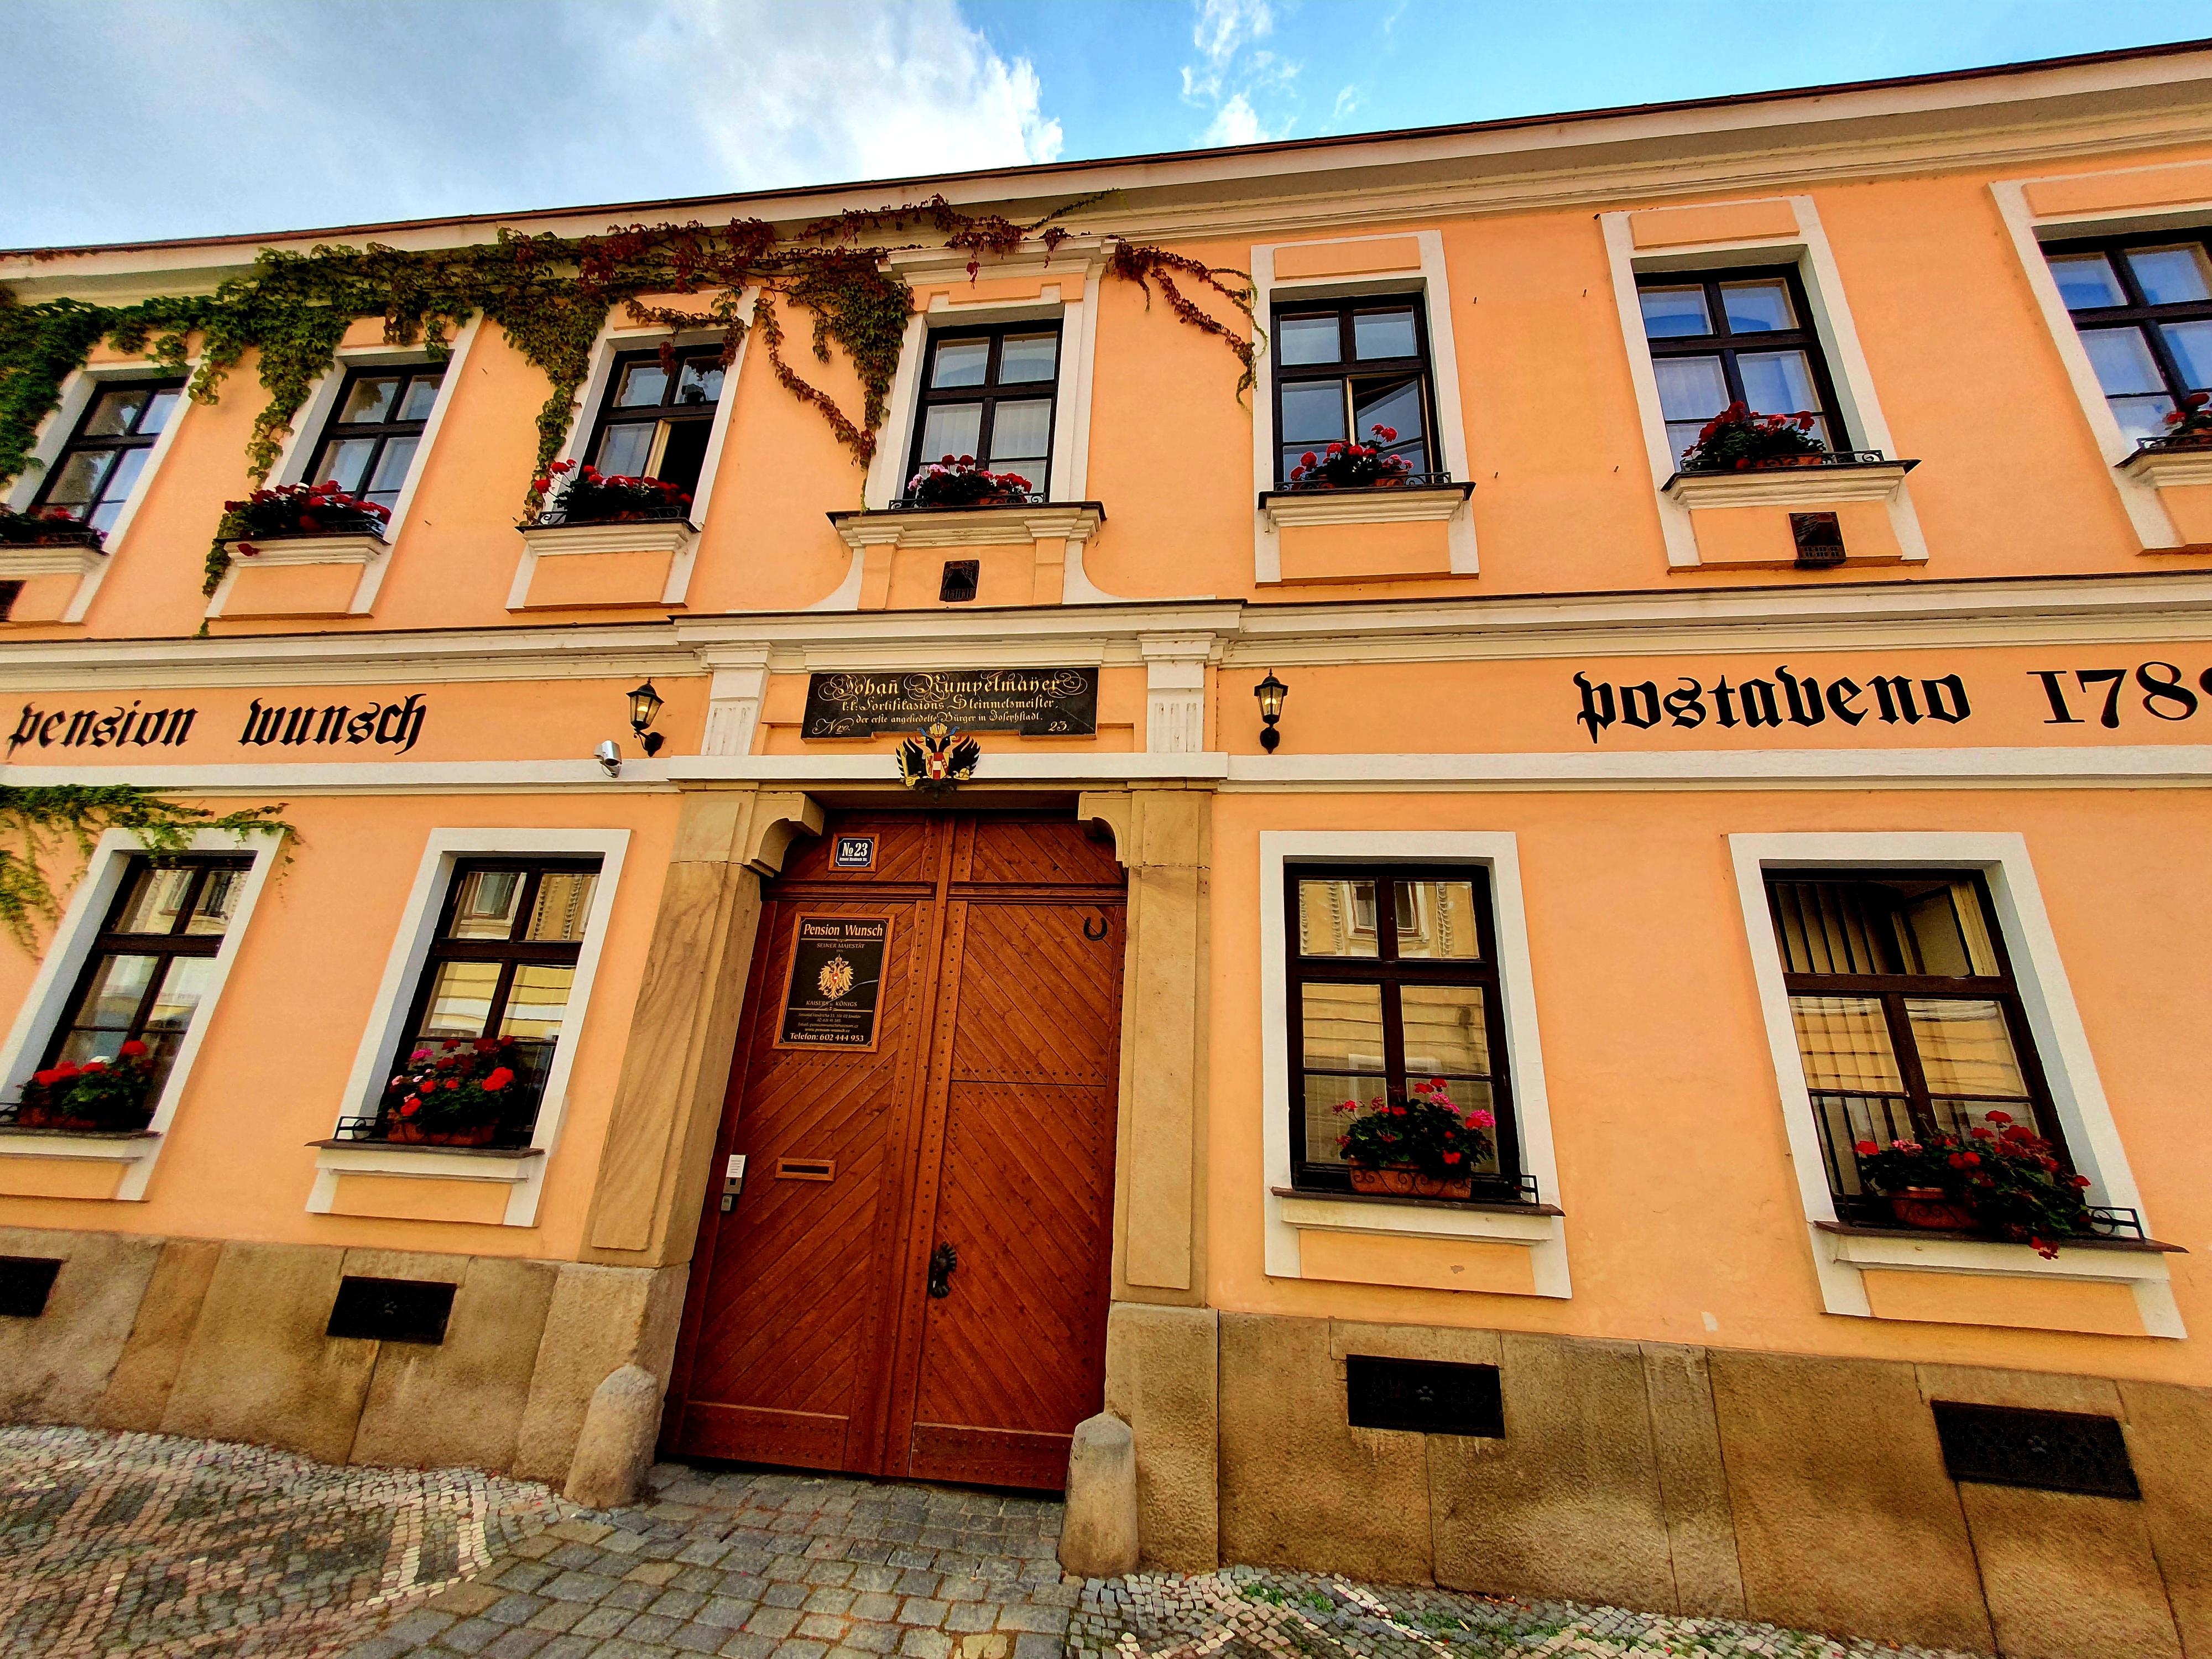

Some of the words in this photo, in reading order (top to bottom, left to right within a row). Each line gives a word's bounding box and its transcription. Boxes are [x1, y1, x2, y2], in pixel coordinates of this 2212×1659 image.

[1573, 664, 1973, 745] postaveno
[2025, 660, 2212, 729] 178
[856, 714, 869, 724] der
[871, 713, 888, 724] erste
[937, 711, 977, 724] Bürger
[978, 713, 986, 722] in
[6, 699, 199, 760] pension
[238, 693, 427, 755] wunsch
[854, 842, 868, 857] 23
[804, 924, 840, 935] Pension
[845, 924, 883, 936] Wunsch
